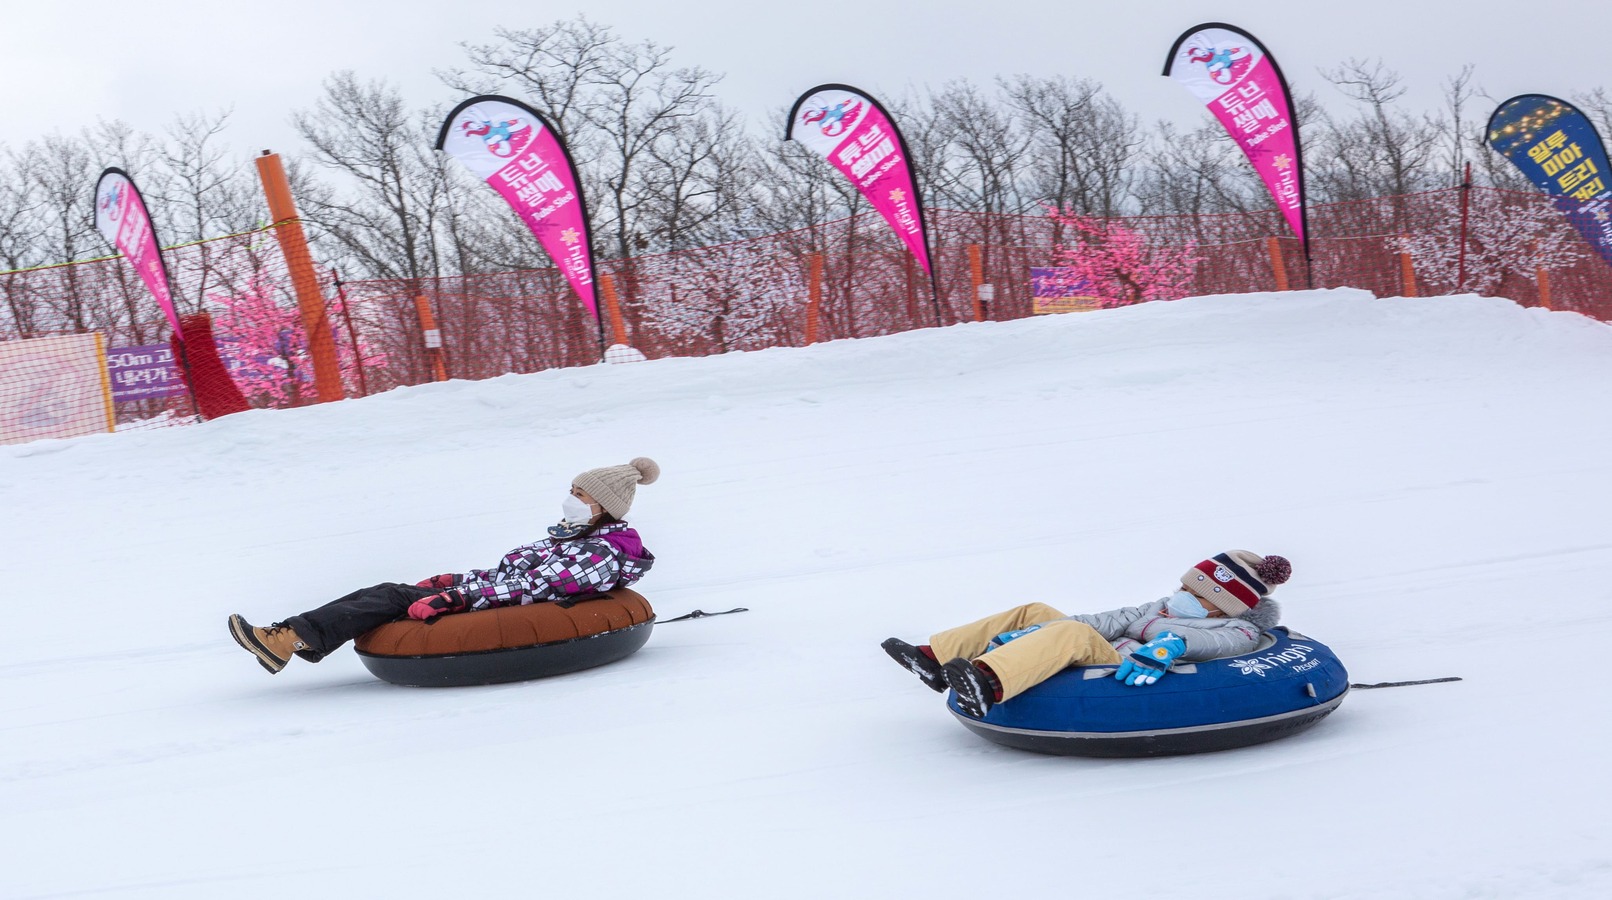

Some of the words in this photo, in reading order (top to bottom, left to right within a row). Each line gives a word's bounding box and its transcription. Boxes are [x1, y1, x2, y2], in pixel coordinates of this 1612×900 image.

[1219, 81, 1265, 115] 튜브
[1234, 99, 1278, 133] 썰매
[1247, 132, 1269, 146] Tube
[1267, 119, 1288, 134] Sled
[838, 124, 885, 164] 튜브
[1528, 130, 1568, 163] 일루
[1542, 143, 1582, 176] 미아
[499, 153, 548, 188] 튜브
[1558, 158, 1598, 193] 트리
[516, 171, 565, 206] 썰매
[532, 206, 556, 220] Tube
[553, 191, 574, 207] Sled
